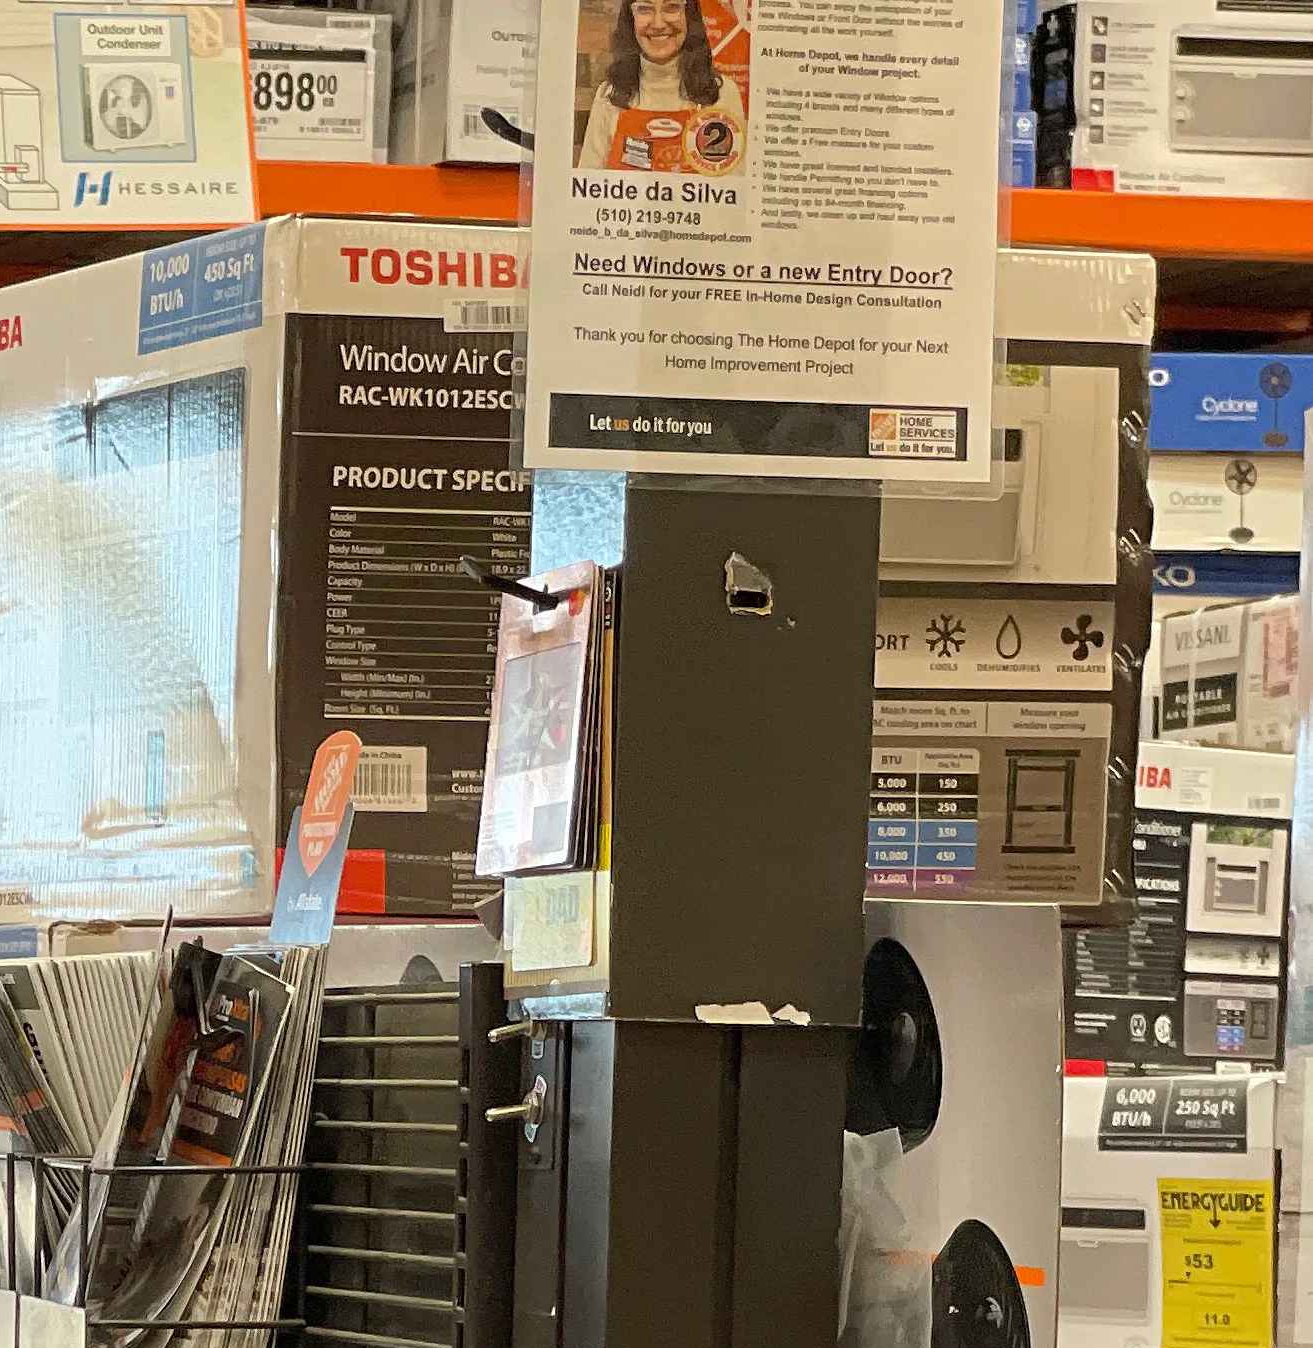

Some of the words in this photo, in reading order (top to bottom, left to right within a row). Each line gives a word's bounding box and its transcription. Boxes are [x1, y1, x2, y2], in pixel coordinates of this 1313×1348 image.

[88, 24, 136, 35] Outdoor
[139, 24, 163, 35] Unit
[97, 38, 161, 50] Condenser
[776, 48, 806, 58] Home
[809, 50, 842, 62] Depot,
[845, 53, 858, 61] we
[862, 53, 896, 63] handle
[900, 56, 927, 66] every
[931, 56, 959, 66] detail
[799, 64, 809, 73] of
[812, 66, 834, 75] your
[838, 66, 878, 76] Window
[882, 69, 920, 79] project.
[119, 182, 238, 195] HESSAIRE
[572, 177, 638, 200] Neide
[646, 181, 673, 201] da
[681, 182, 737, 204] Silva
[596, 208, 632, 225] (510)
[636, 210, 701, 225] 219-9748
[150, 254, 190, 284] 10,000
[204, 260, 225, 282] 450
[227, 258, 241, 280] Sq
[242, 252, 254, 274] Ft
[575, 253, 625, 272] Need
[633, 256, 726, 277] Windows
[733, 264, 754, 278] or
[760, 265, 771, 278] a
[779, 266, 821, 280] new
[828, 264, 882, 285] Entry
[890, 265, 953, 285] Door?
[582, 283, 607, 296] Call
[650, 286, 668, 298] for
[672, 290, 702, 302] your
[705, 289, 741, 301] FREE
[746, 290, 802, 304] In-Home
[806, 293, 852, 308] Design
[857, 294, 941, 309] Consultation
[574, 327, 616, 342] Thank
[620, 332, 644, 345] you
[649, 330, 667, 344] for
[671, 332, 733, 349] choosing
[738, 334, 764, 347] The
[769, 335, 809, 349] Home
[814, 336, 855, 353] Depot
[859, 338, 878, 351] for
[882, 341, 912, 355] your
[916, 340, 948, 354] Next
[340, 344, 448, 373] Window
[453, 348, 488, 374] Air
[665, 355, 706, 369] Home
[711, 356, 800, 373] Improvement
[806, 360, 853, 377] Project
[590, 414, 611, 430] Let
[614, 419, 629, 431] us
[633, 416, 651, 432] do
[654, 417, 663, 432] it
[666, 418, 685, 433] for
[687, 422, 711, 436] you
[900, 417, 933, 427] HOME
[900, 428, 954, 438] SERVICES
[329, 528, 352, 538] Color
[327, 576, 363, 587] Capacity
[326, 624, 344, 635] Plug
[346, 625, 365, 635] Type
[326, 640, 356, 649] Control
[358, 641, 376, 652] Type
[881, 755, 902, 765] BTU
[1116, 1088, 1156, 1106] 6,000
[1176, 1101, 1199, 1116] 250
[1203, 1101, 1219, 1117] Sq
[1221, 1101, 1236, 1115] Ft
[1112, 1111, 1151, 1127] BTU/h
